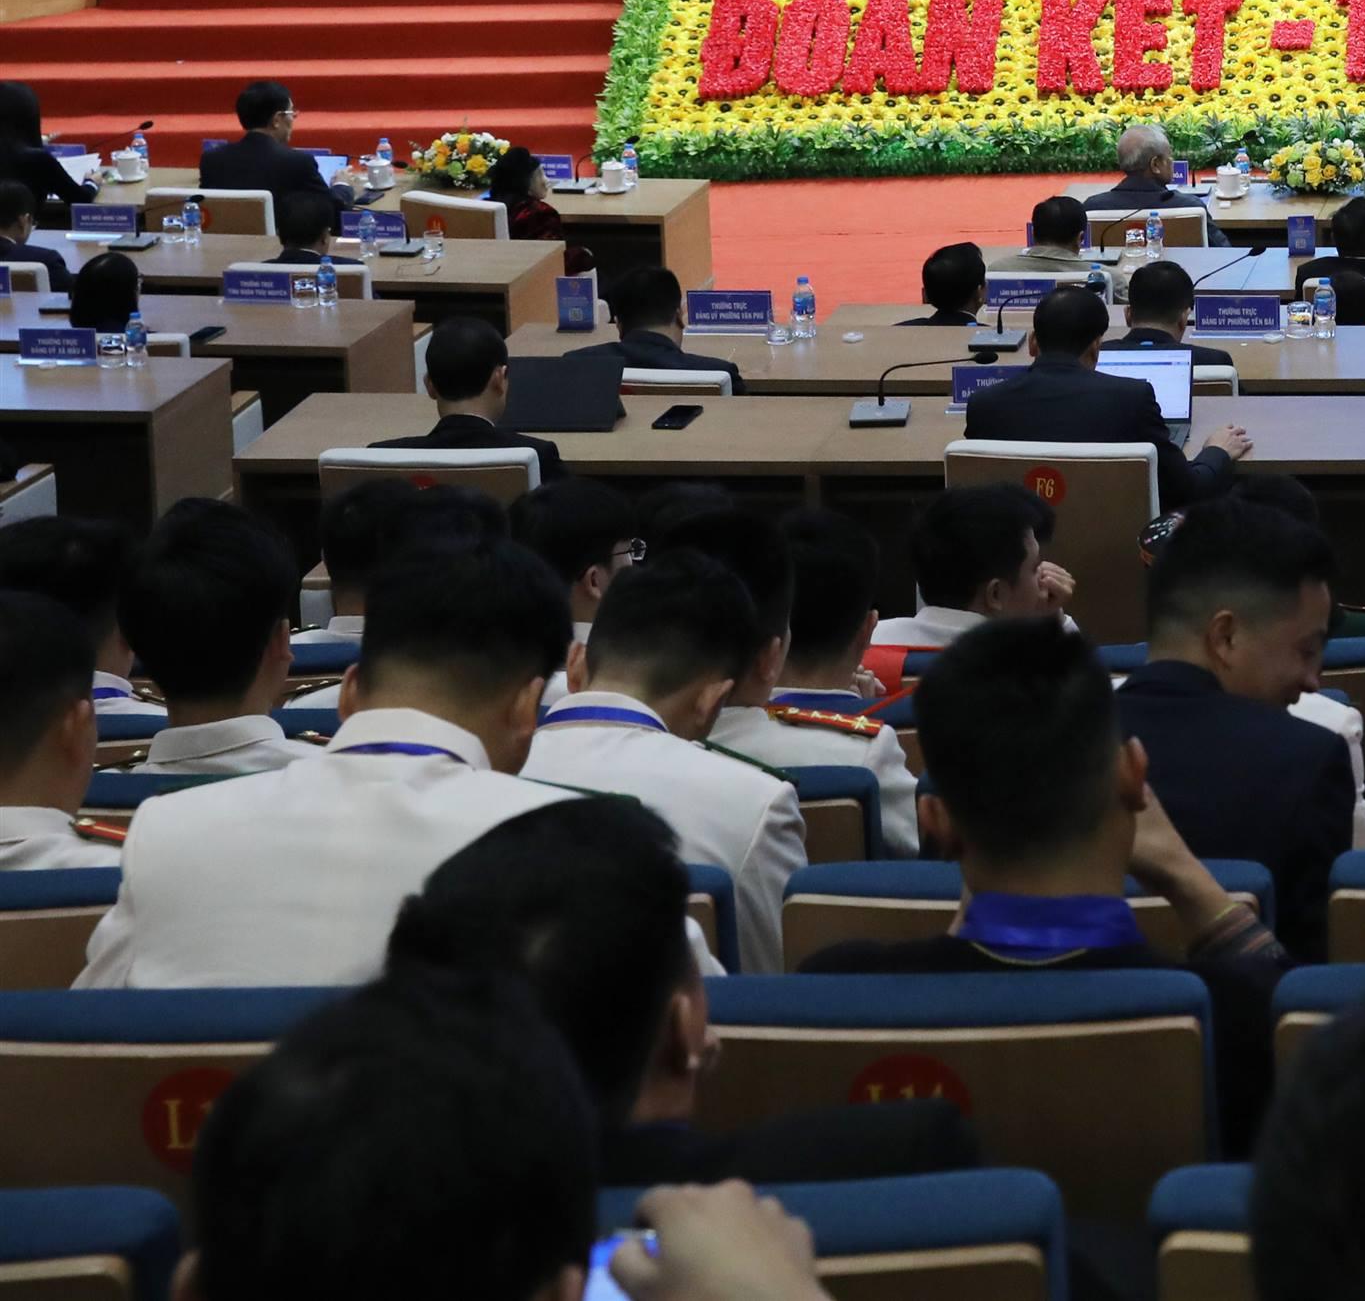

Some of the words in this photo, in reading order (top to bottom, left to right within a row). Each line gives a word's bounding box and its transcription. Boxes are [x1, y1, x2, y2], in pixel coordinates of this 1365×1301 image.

[1270, 19, 1316, 51] -
[976, 378, 1008, 387] THƯỜ
[1036, 477, 1055, 498] F6
